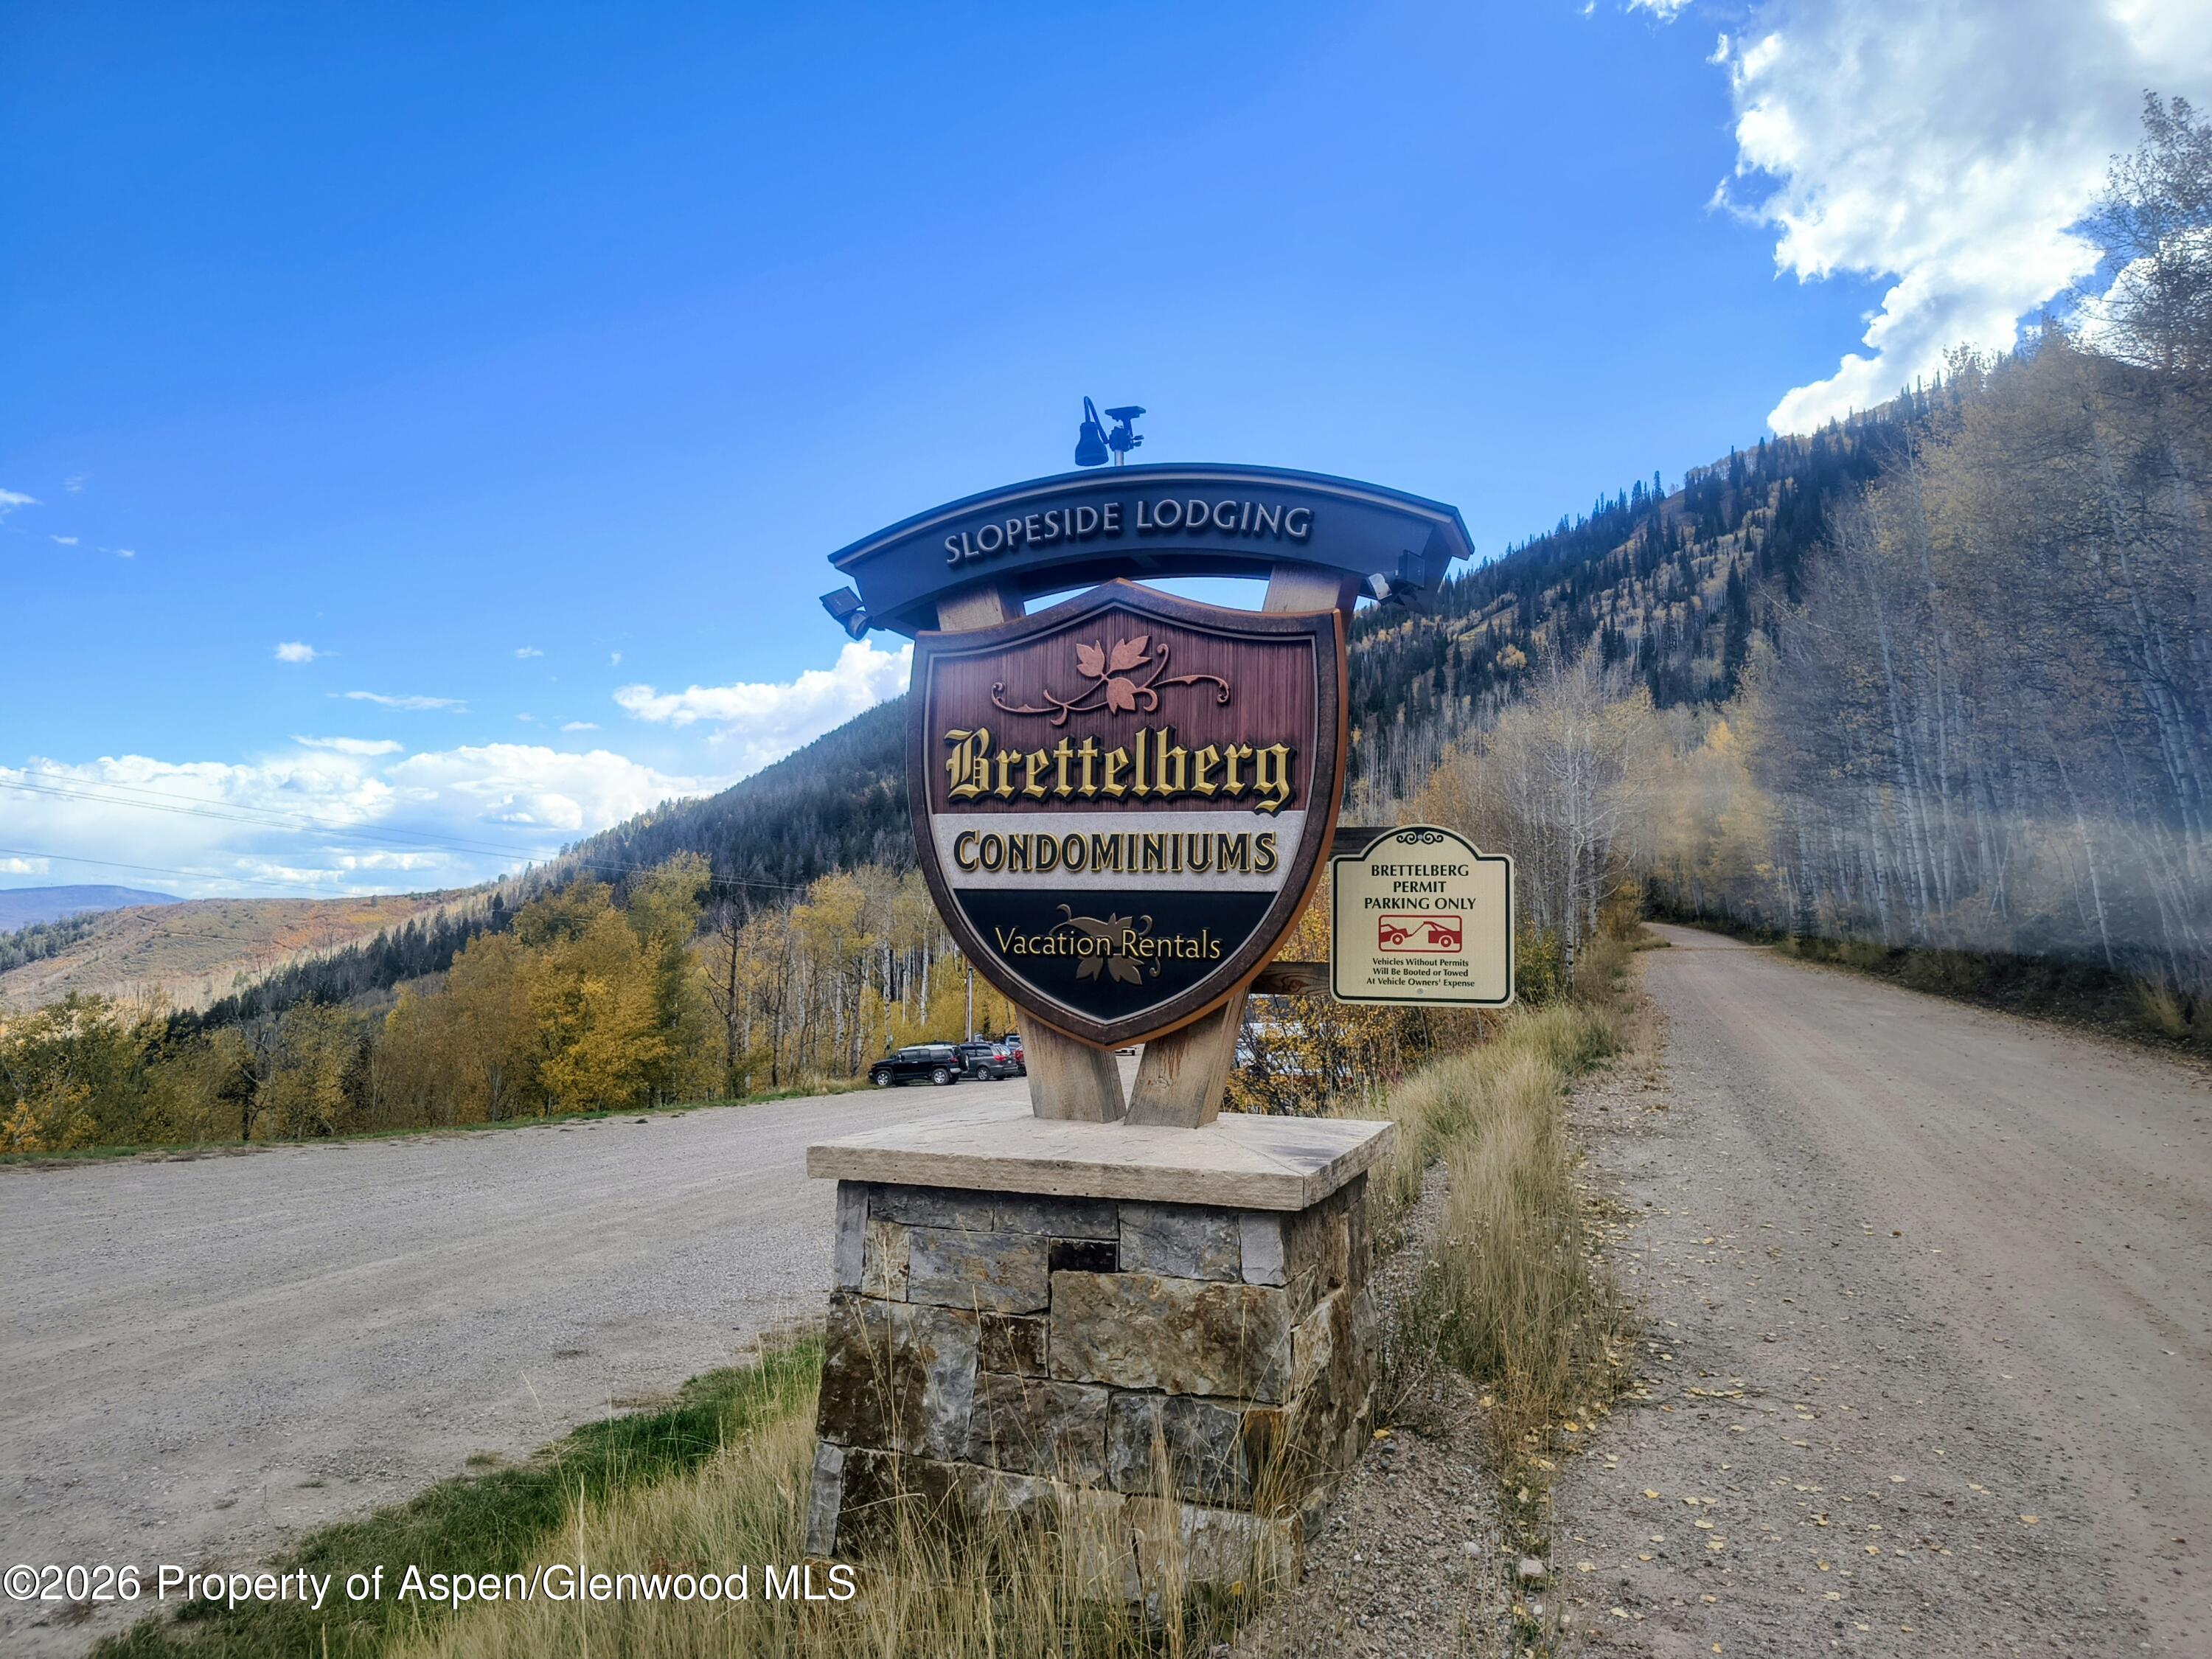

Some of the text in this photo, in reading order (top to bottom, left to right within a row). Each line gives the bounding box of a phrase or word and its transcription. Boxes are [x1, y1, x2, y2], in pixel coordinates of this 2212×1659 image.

[943, 498, 1312, 565] SLOPESIDE LODGING
[945, 726, 1291, 812] Brettelberg
[953, 830, 1279, 873] CONDOMINIUMS
[1371, 864, 1470, 877] BRETTELBERG
[1393, 881, 1447, 893] PERMIT
[1364, 897, 1476, 910] PARKING ONLY
[995, 927, 1221, 959] Vacation Rentals
[1372, 957, 1469, 967] Vehicles Without Permits
[1373, 967, 1388, 975] Will
[1391, 967, 1401, 975] Be
[1443, 968, 1469, 977] Towed
[1377, 977, 1405, 985] Vehicle
[1408, 978, 1441, 986] Owners'
[1443, 978, 1475, 989] Expense
